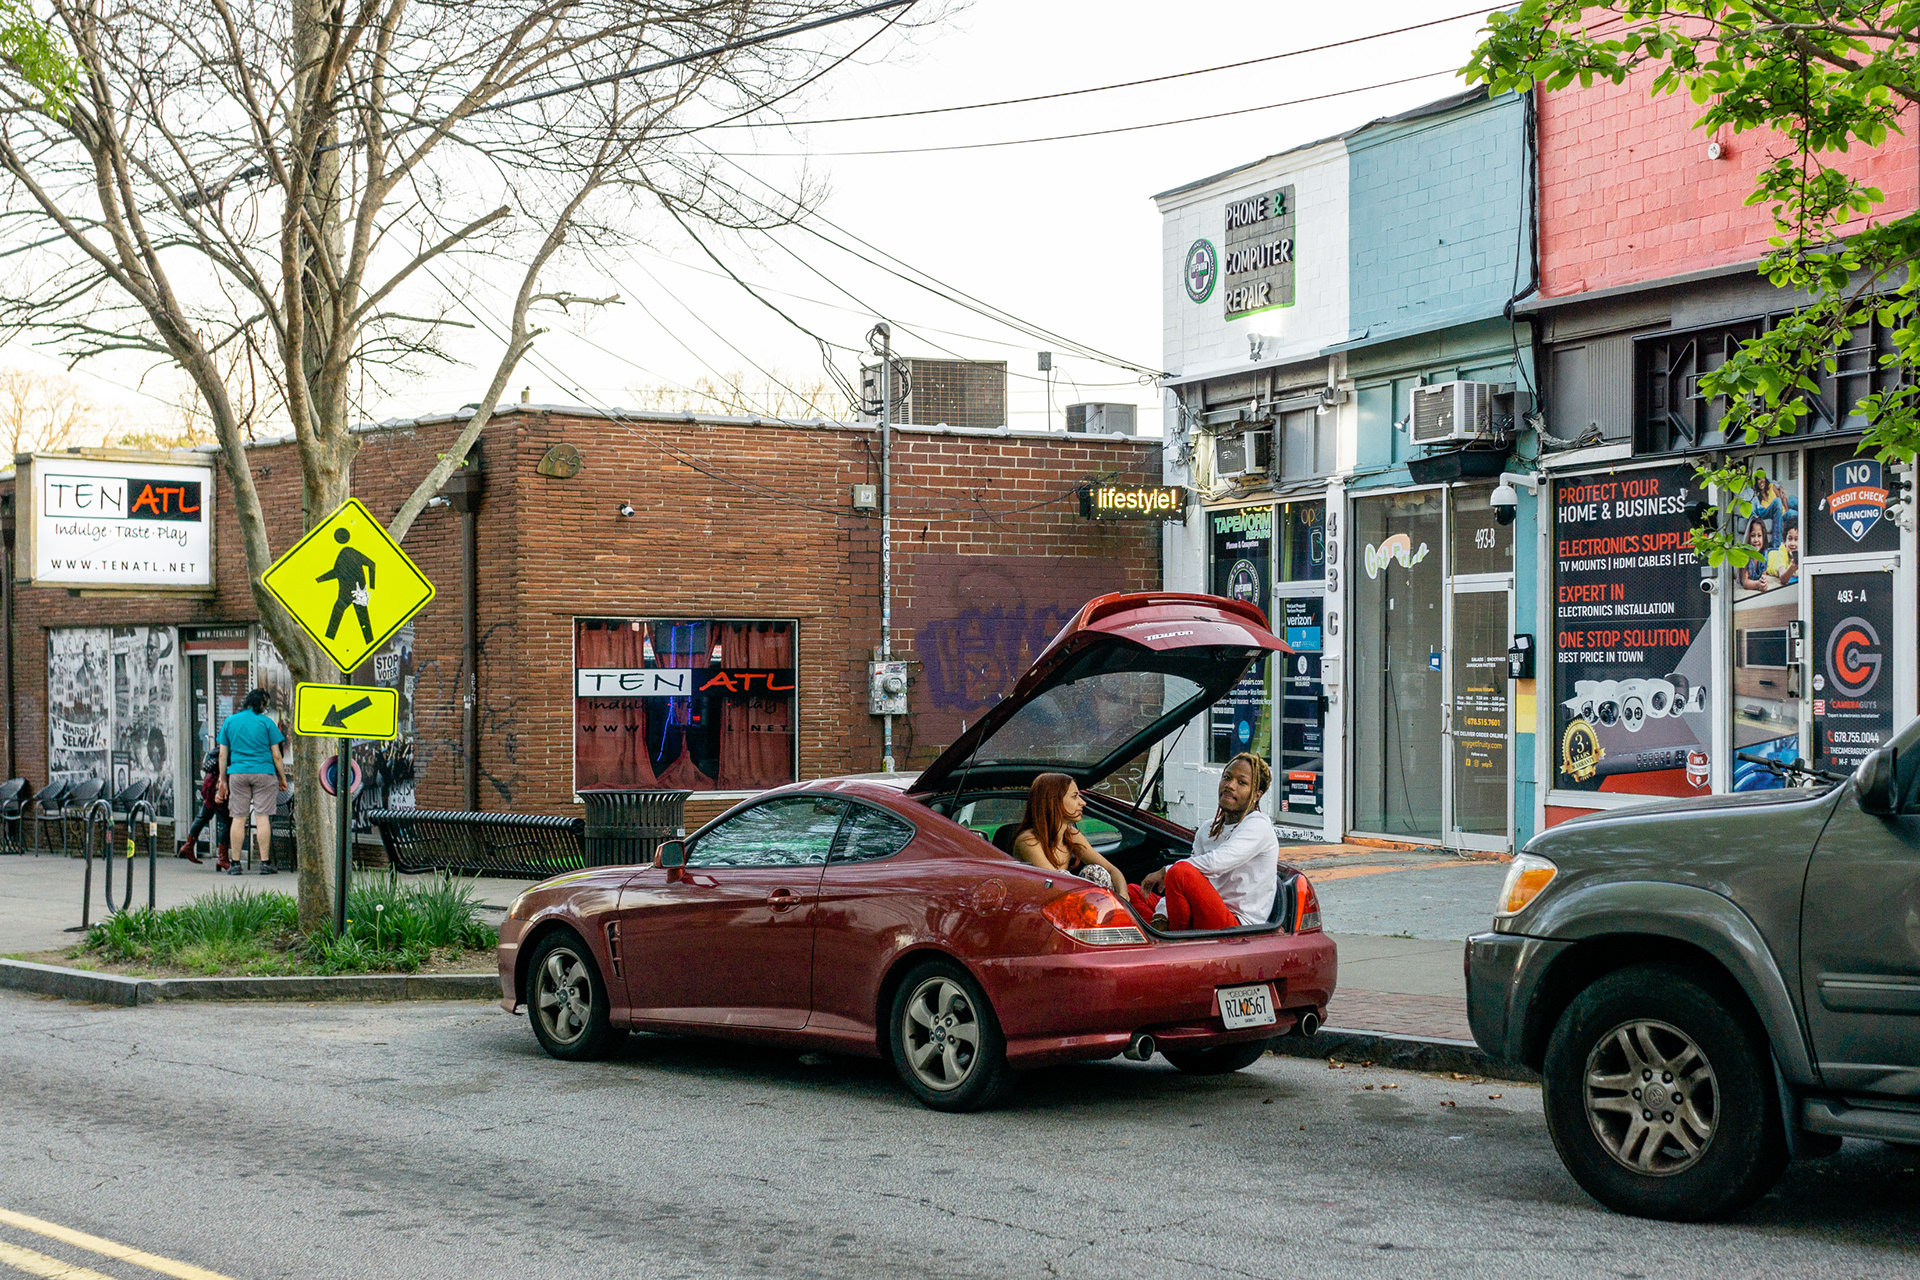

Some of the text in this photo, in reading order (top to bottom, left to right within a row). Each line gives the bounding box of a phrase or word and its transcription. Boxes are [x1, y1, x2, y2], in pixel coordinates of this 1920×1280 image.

[1226, 192, 1285, 230] PHONE &
[1225, 238, 1291, 275] COMPUTER
[1225, 281, 1270, 313] REPAIR
[1846, 464, 1870, 484] NO
[50, 483, 200, 515] TEN ATL
[1098, 487, 1176, 514] lifestyle!
[1559, 478, 1659, 504] PROTECT YOUR
[1832, 491, 1885, 507] CREDIT CHECK
[1558, 495, 1686, 523] HOME & BUSINESS
[1837, 509, 1879, 520] FINANCING
[1214, 512, 1271, 534] TAPEWORM
[55, 522, 188, 547] Indulge Taste Play
[1246, 529, 1271, 540] REPAIRS
[1475, 528, 1496, 549] 493-B
[1559, 535, 1640, 558] ELECTRONICS
[51, 559, 196, 573] WWW.TENATL.NET
[1560, 552, 1698, 572] TV MOUNTS HDMI CABLES ETC.
[1559, 583, 1624, 602] EXPERT IN
[1837, 590, 1853, 602] 493
[1860, 589, 1867, 602] A
[1558, 602, 1674, 617] ELECTRONICS INSTALLATION
[1286, 614, 1312, 626] verizon
[1559, 628, 1690, 648] ONE STOP SOLUTION
[376, 654, 398, 670] STOP
[1558, 651, 1643, 663] BEST PRICE IN TOWN
[378, 668, 398, 680] VOTER
[585, 671, 795, 692] TEN ATL
[1832, 701, 1877, 709] CAMERAGUYS
[63, 722, 89, 736] MARCH
[1468, 718, 1500, 726] 678.515.7601
[1574, 734, 1585, 754] 3
[1834, 732, 1879, 743] 678.755.0044
[1572, 758, 1595, 769] WARRANTY
[1573, 752, 1591, 762] YEARS
[1230, 989, 1258, 998] GEORGIA
[1225, 996, 1266, 1018] RZA2567
